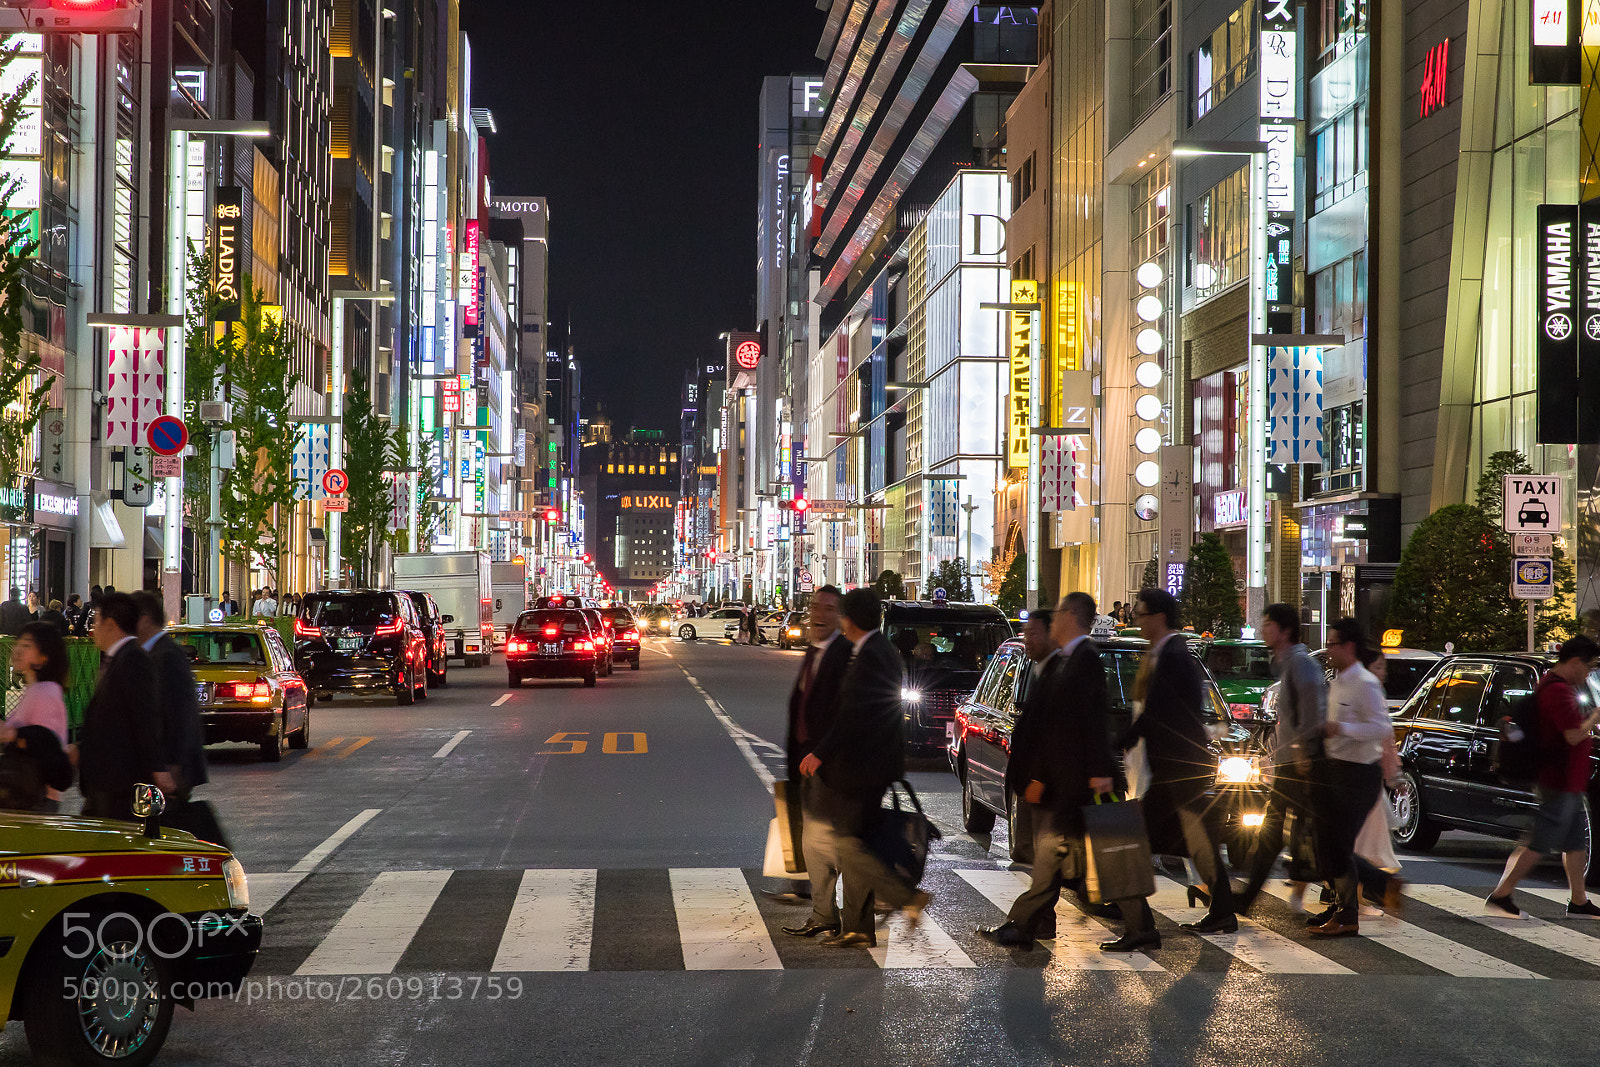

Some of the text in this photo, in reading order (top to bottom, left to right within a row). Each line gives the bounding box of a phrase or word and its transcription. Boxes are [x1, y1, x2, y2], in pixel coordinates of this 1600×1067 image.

[1420, 37, 1449, 118] H&M
[216, 225, 238, 301] LLADRÓ
[1546, 222, 1571, 312] YAMAHA
[1512, 480, 1556, 495] TAXI
[635, 495, 673, 509] LIXIL
[1167, 575, 1183, 586] 21
[1094, 627, 1108, 635] 878
[537, 732, 649, 755] 50
[182, 857, 211, 873] 足立
